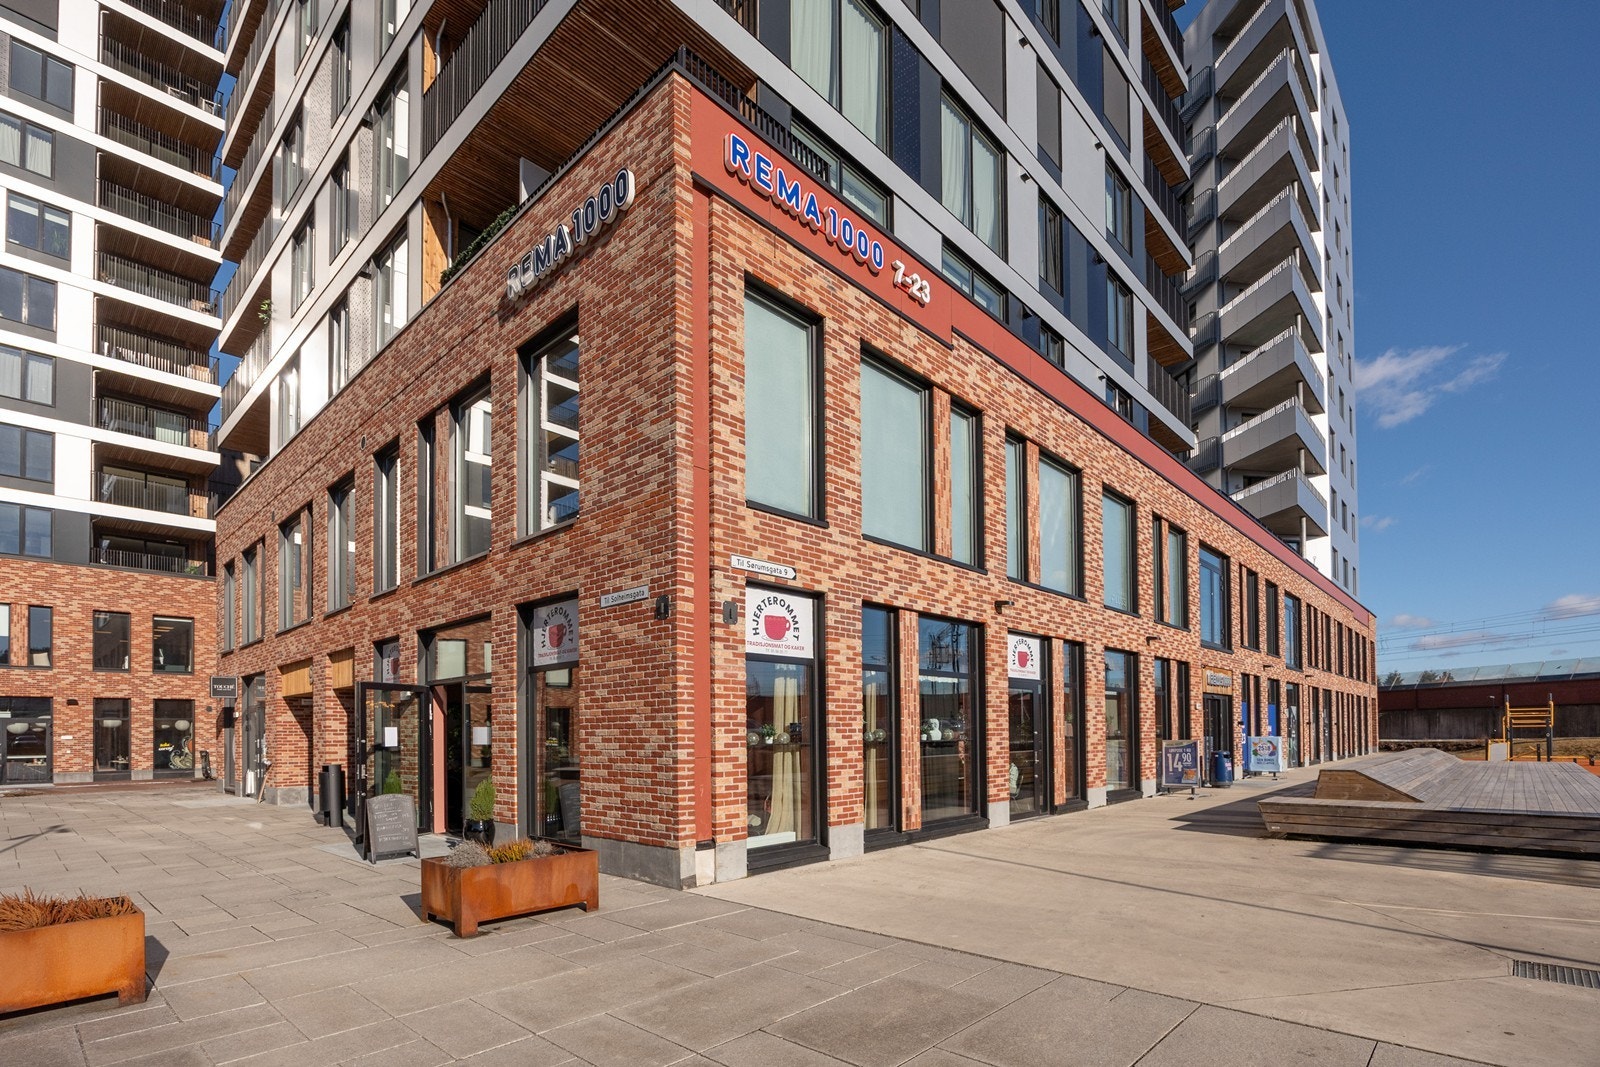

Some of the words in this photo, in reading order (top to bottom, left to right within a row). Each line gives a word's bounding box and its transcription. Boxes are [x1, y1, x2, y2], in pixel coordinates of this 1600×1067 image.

[725, 132, 822, 231] REMA
[825, 206, 884, 272] 1000
[891, 259, 931, 304] 7-23
[507, 223, 573, 301] REMA
[572, 167, 635, 246] 1000
[736, 559, 745, 567] Til
[746, 560, 782, 575] Sørumsgata
[783, 568, 788, 576] 9
[610, 590, 645, 603] Solheimsgata
[541, 606, 574, 648] HJERTEROMMET
[752, 596, 800, 641] HJERTEROMMET
[747, 640, 784, 649] TRADISJONSMAT
[1167, 753, 1183, 772] 14
[1182, 752, 1192, 762] 90
